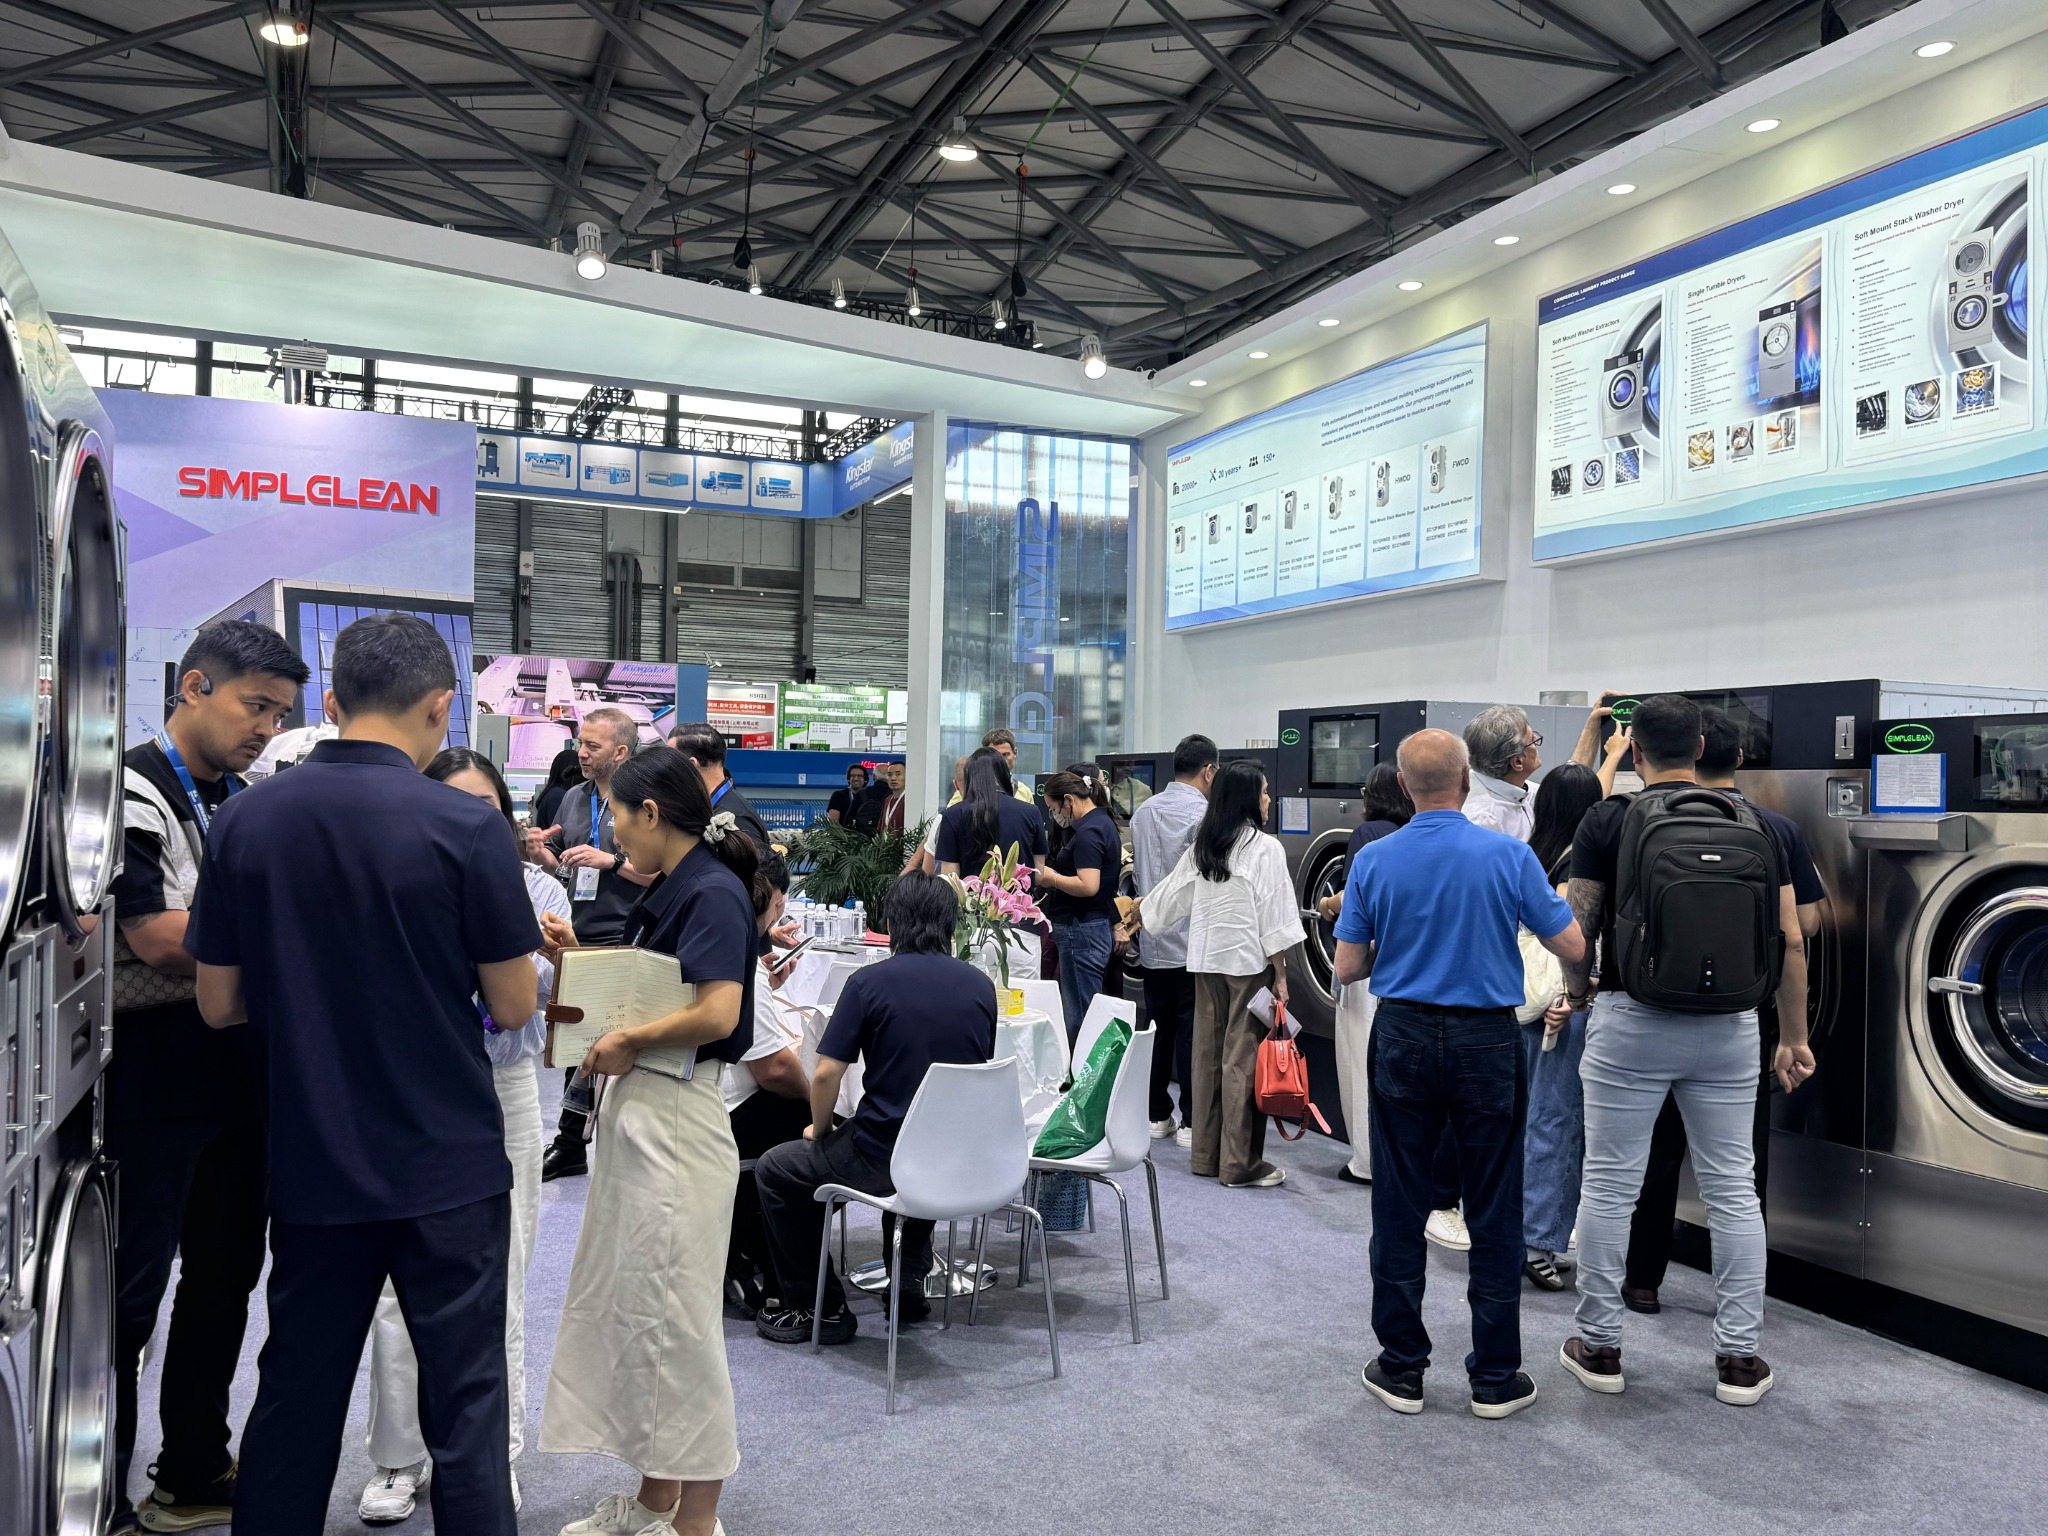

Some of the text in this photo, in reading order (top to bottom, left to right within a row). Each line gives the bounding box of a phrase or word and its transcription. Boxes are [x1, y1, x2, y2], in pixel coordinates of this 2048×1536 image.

[1854, 198, 1965, 241] Soft Mount Stack Washer Dryer
[1600, 275, 1620, 286] PRODUCT
[1688, 288, 1705, 299] Single
[1706, 280, 1726, 292] Tumble
[1726, 274, 1746, 285] Dryers
[1552, 337, 1561, 346] Soft
[1562, 332, 1577, 342] Mount
[1577, 327, 1595, 337] Washer
[1595, 319, 1620, 331] Extractors
[846, 456, 875, 485] Kingstar
[1263, 452, 1276, 463] 150+
